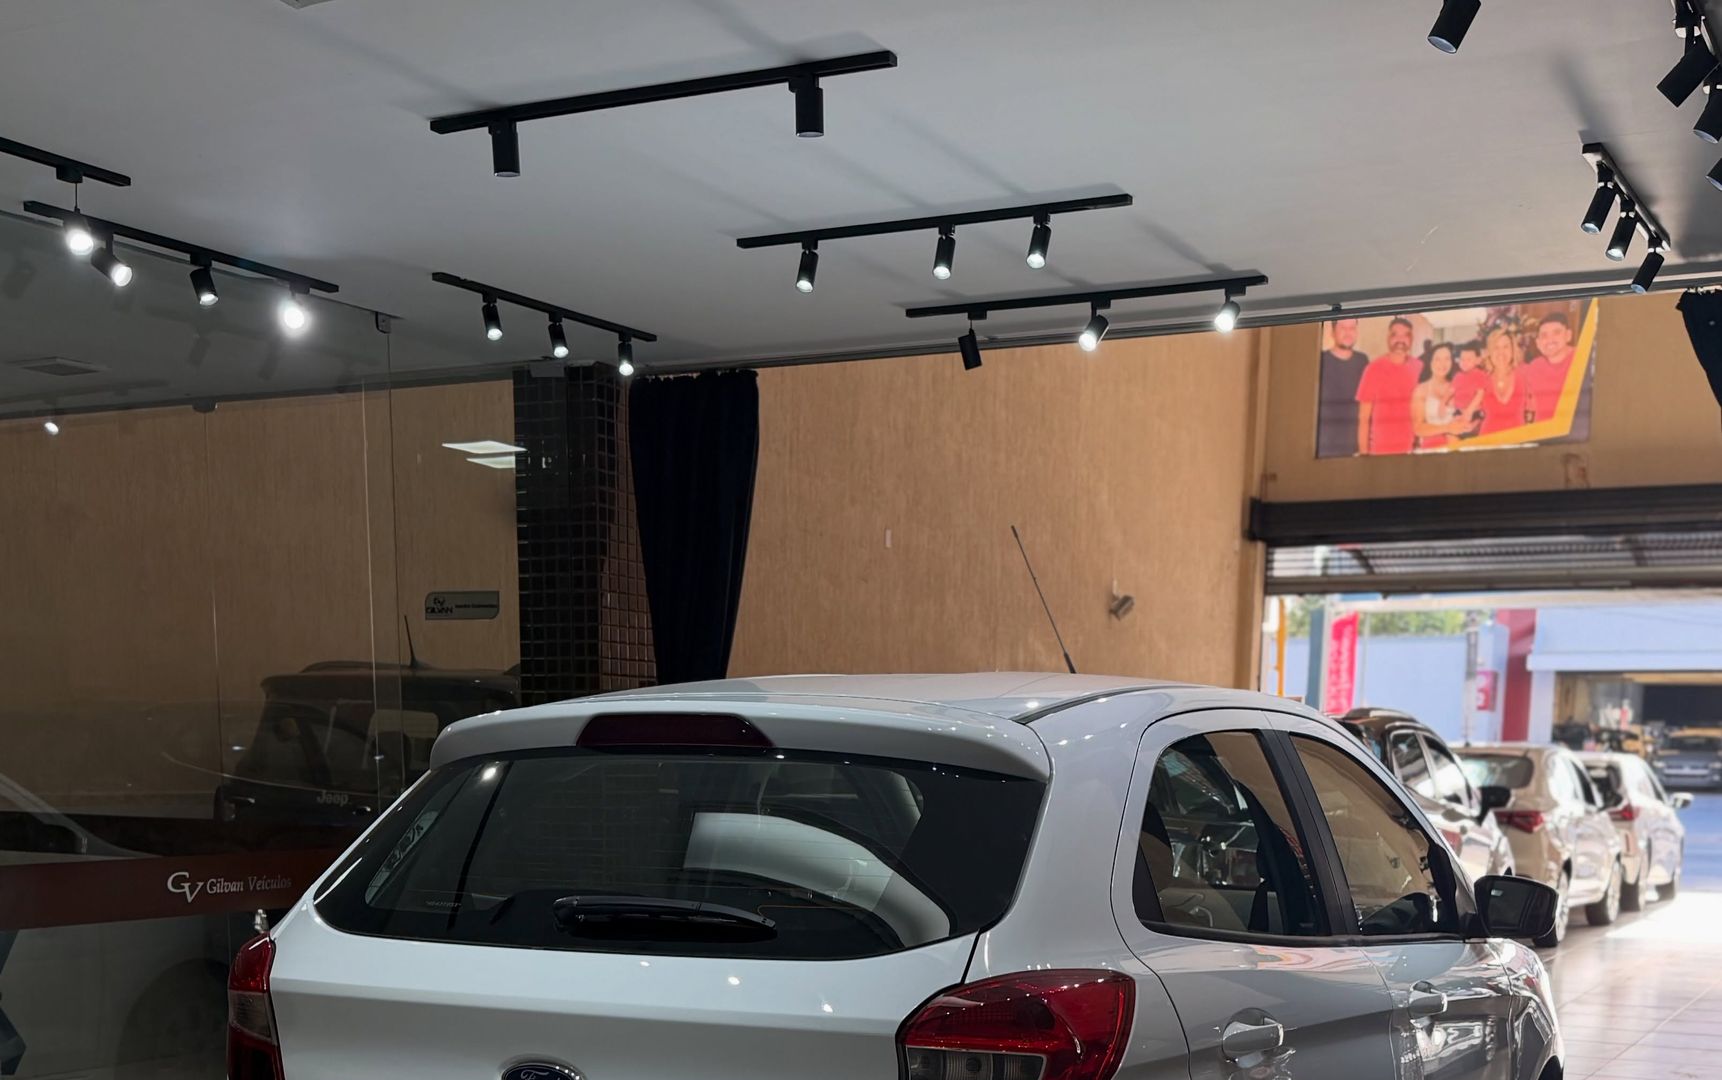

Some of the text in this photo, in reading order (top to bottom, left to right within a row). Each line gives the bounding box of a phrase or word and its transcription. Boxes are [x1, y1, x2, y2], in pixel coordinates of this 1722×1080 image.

[316, 790, 349, 807] Jeep
[167, 872, 204, 903] GV
[206, 878, 244, 894] Gilvan
